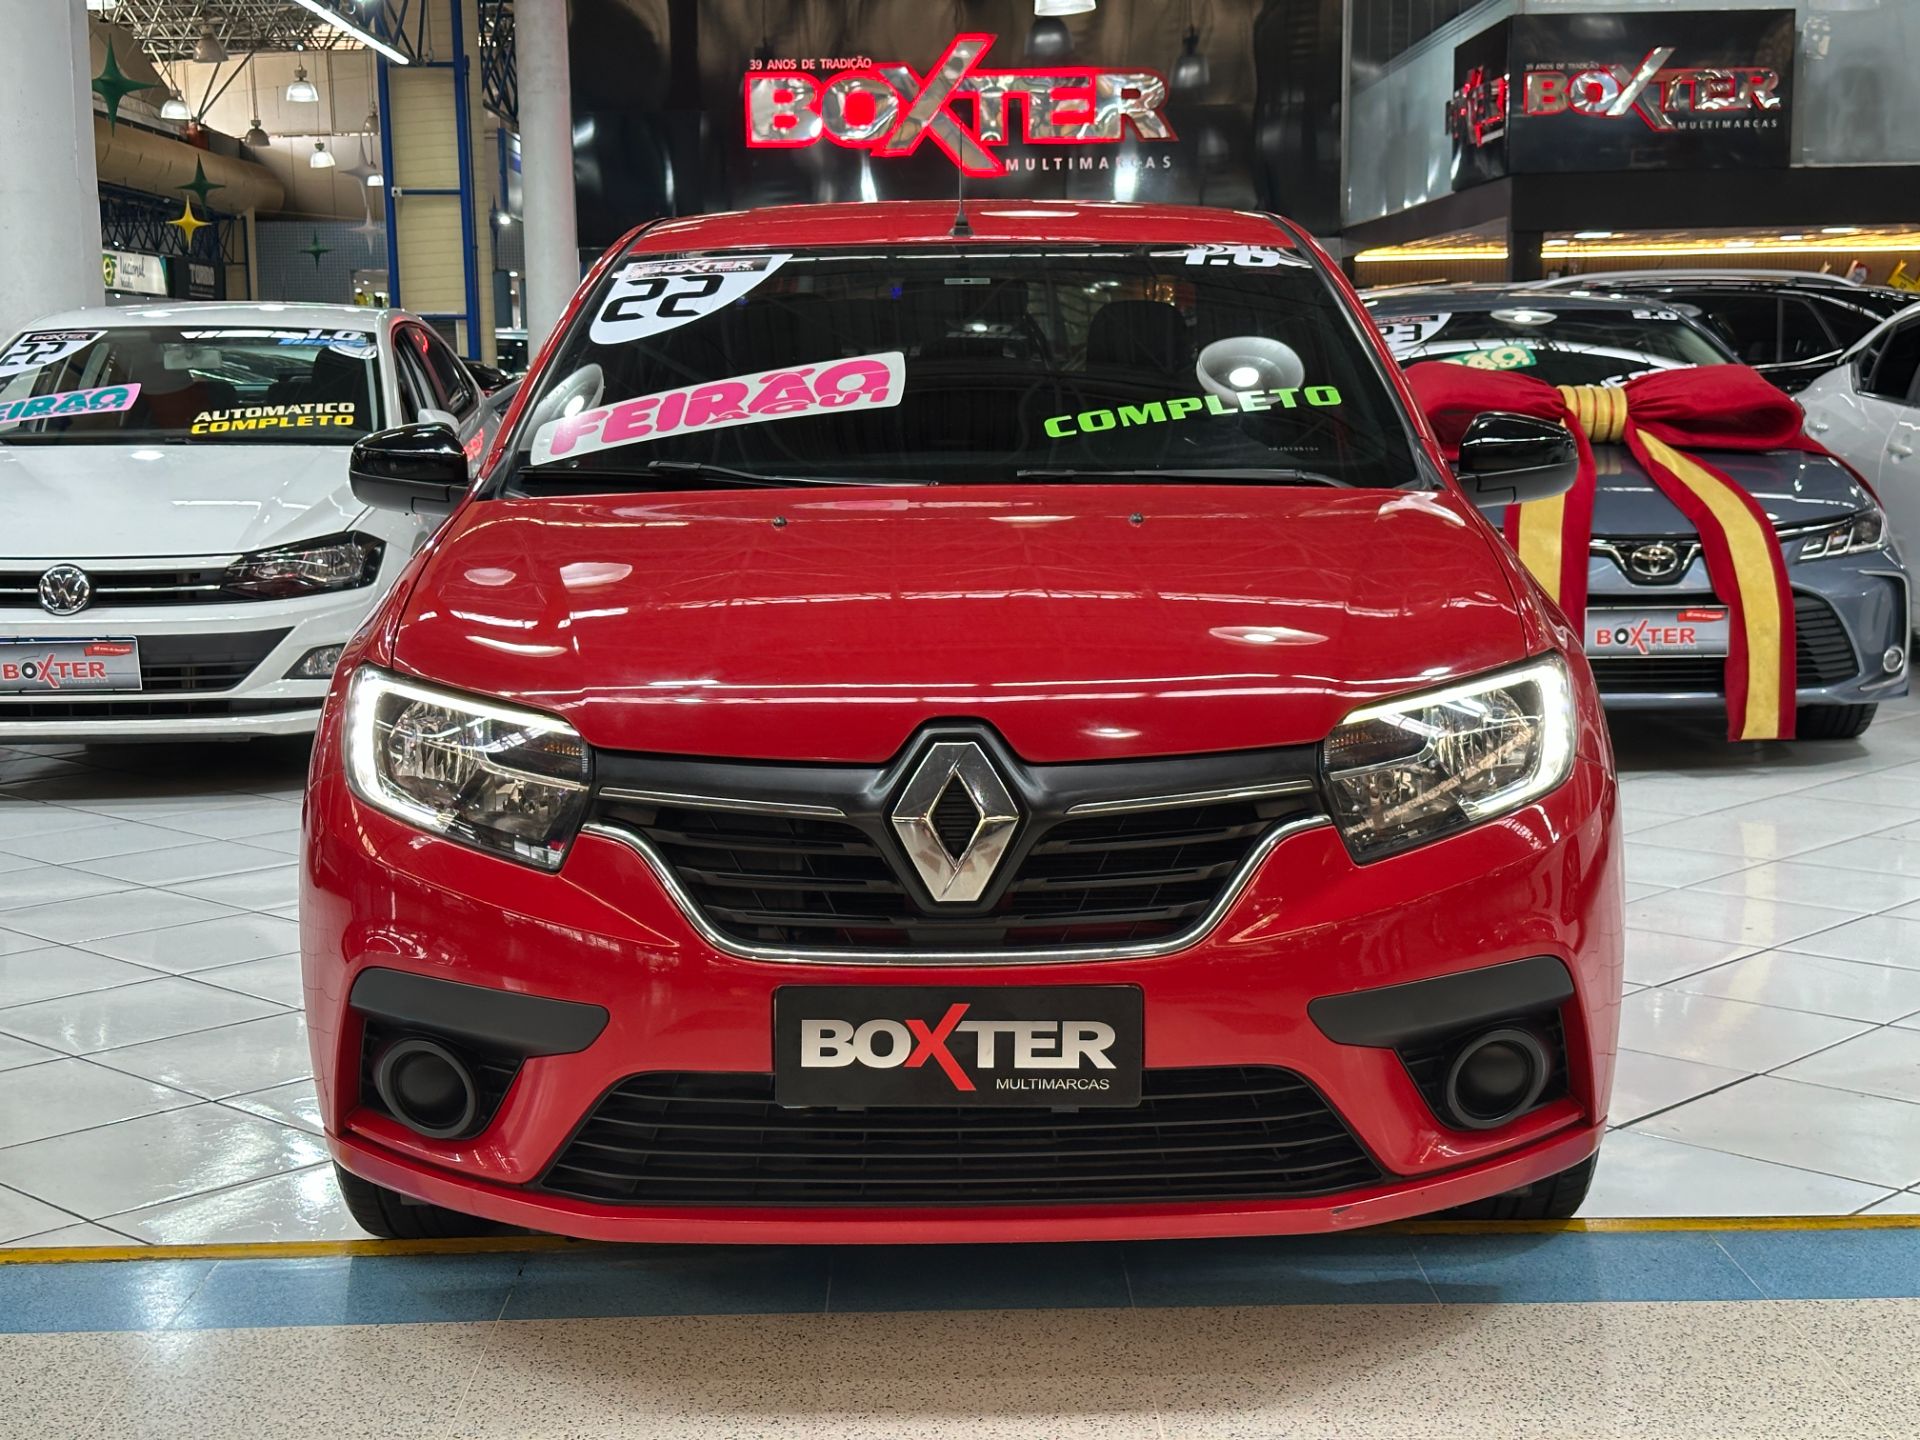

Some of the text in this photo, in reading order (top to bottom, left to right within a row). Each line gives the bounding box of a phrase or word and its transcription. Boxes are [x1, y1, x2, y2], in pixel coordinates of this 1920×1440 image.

[750, 55, 872, 70] 39 ANOS DE TRADIÇÃO
[745, 33, 1179, 177] BOXTER
[1524, 47, 1781, 132] BOXTER
[1677, 119, 1779, 130] MULTIMARCAS
[1006, 155, 1172, 171] MULTIMARCAS
[600, 274, 725, 323] 22
[0, 342, 68, 367] 22
[190, 414, 355, 435] COMPLETO
[193, 402, 355, 423] AUTOMATICO
[550, 359, 891, 456] FEIRÃO
[1044, 385, 1342, 438] COMPLETO
[1595, 618, 1697, 655] BOXTER
[2, 653, 108, 688] BOXTER
[801, 1003, 1117, 1091] BOXTER
[995, 1078, 1110, 1090] MULTIMARCAS
